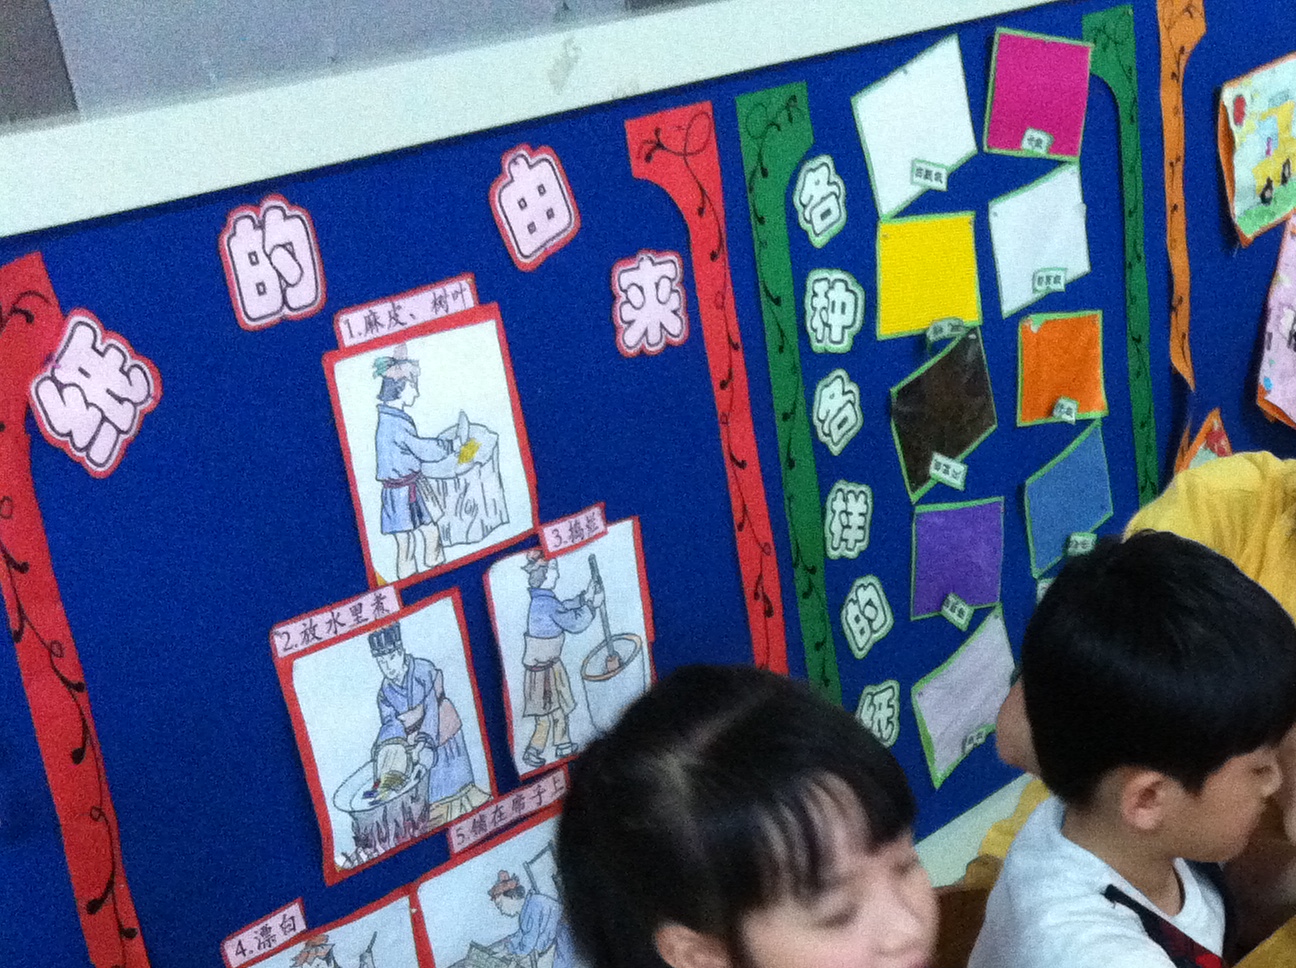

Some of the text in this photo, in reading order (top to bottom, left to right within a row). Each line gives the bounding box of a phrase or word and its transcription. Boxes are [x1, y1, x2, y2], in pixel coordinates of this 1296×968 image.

[33, 152, 683, 468] 纸 的 由 来
